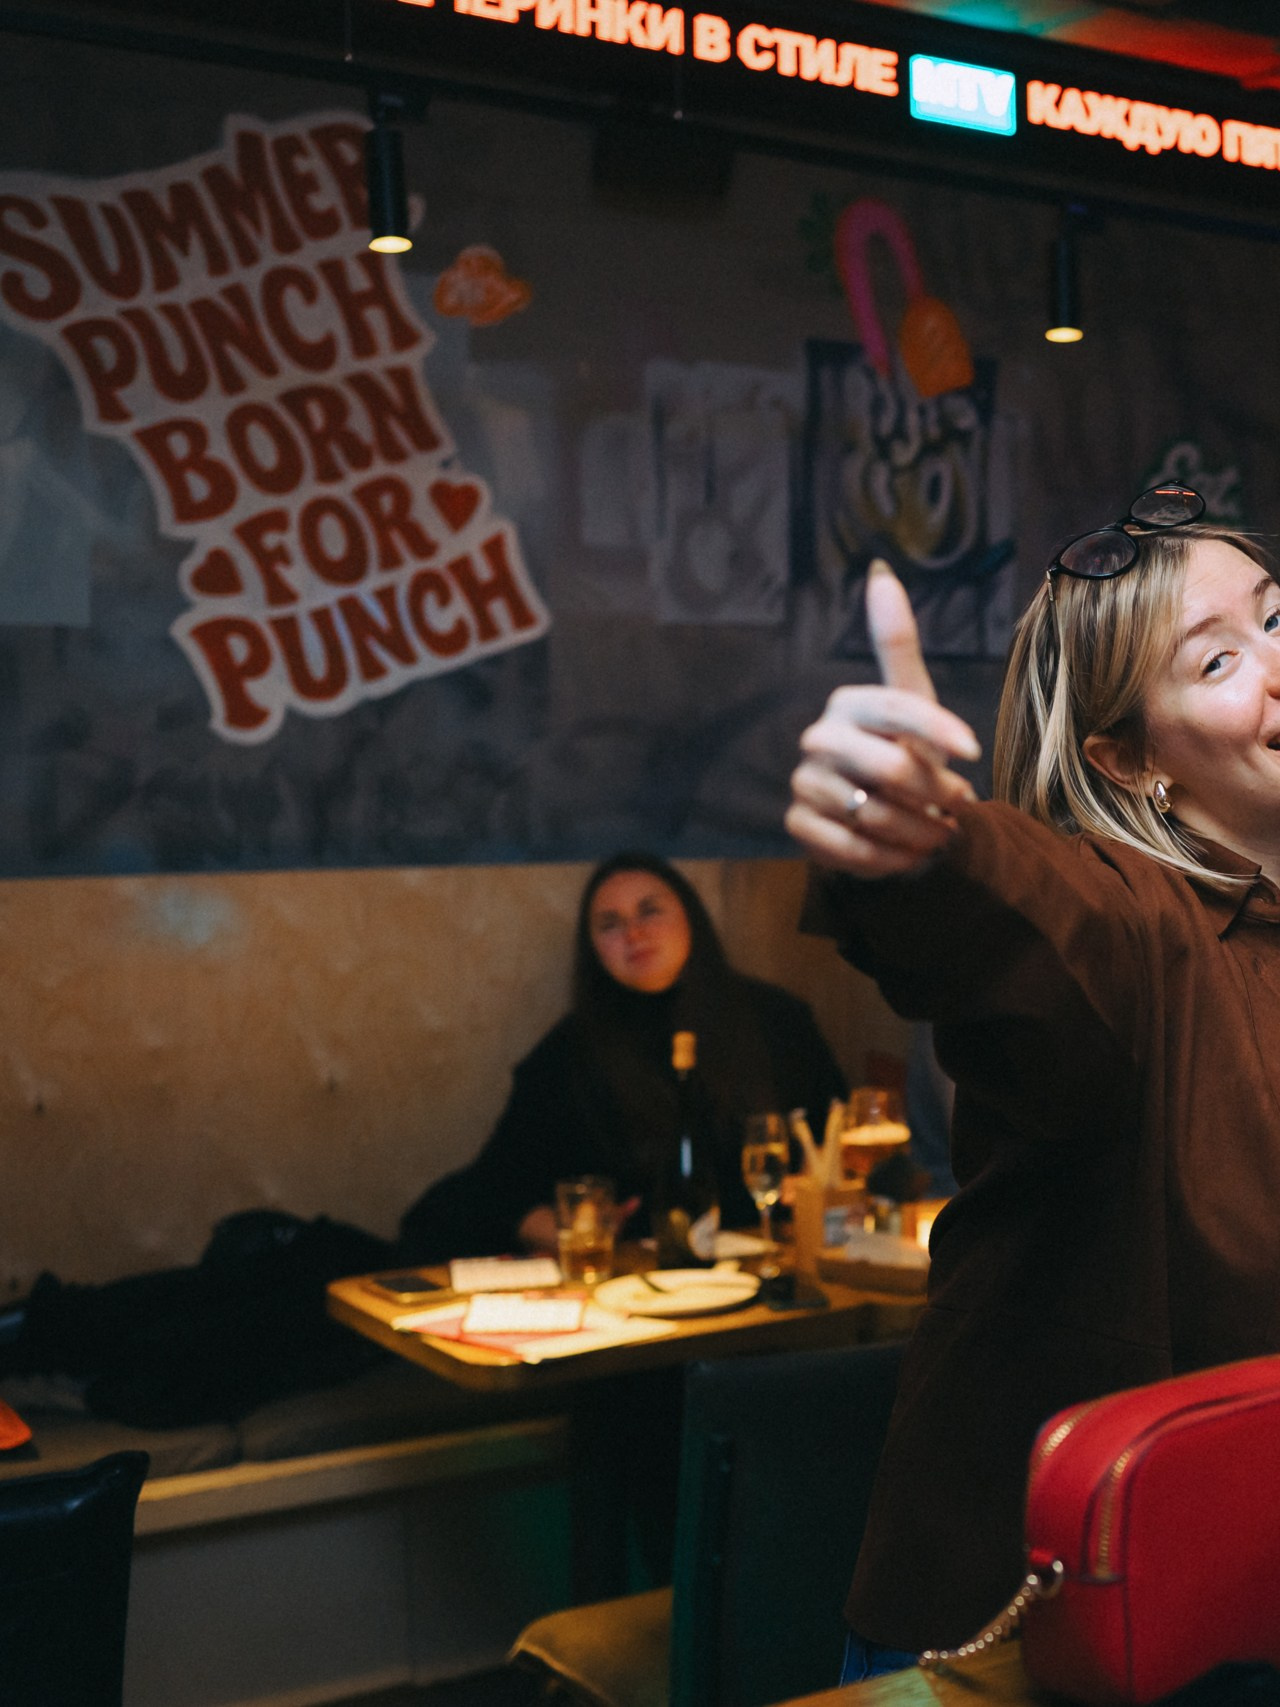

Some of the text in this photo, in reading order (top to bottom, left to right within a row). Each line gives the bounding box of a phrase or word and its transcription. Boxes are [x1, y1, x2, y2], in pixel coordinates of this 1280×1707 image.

[693, 13, 731, 63] В
[736, 23, 899, 97] СТИЛЕ
[1026, 80, 1221, 157] КАЖДУЮ
[62, 252, 421, 424] PUNCH
[133, 365, 442, 523] BORN
[232, 476, 437, 608] FOR
[190, 530, 539, 730] PUNCH
